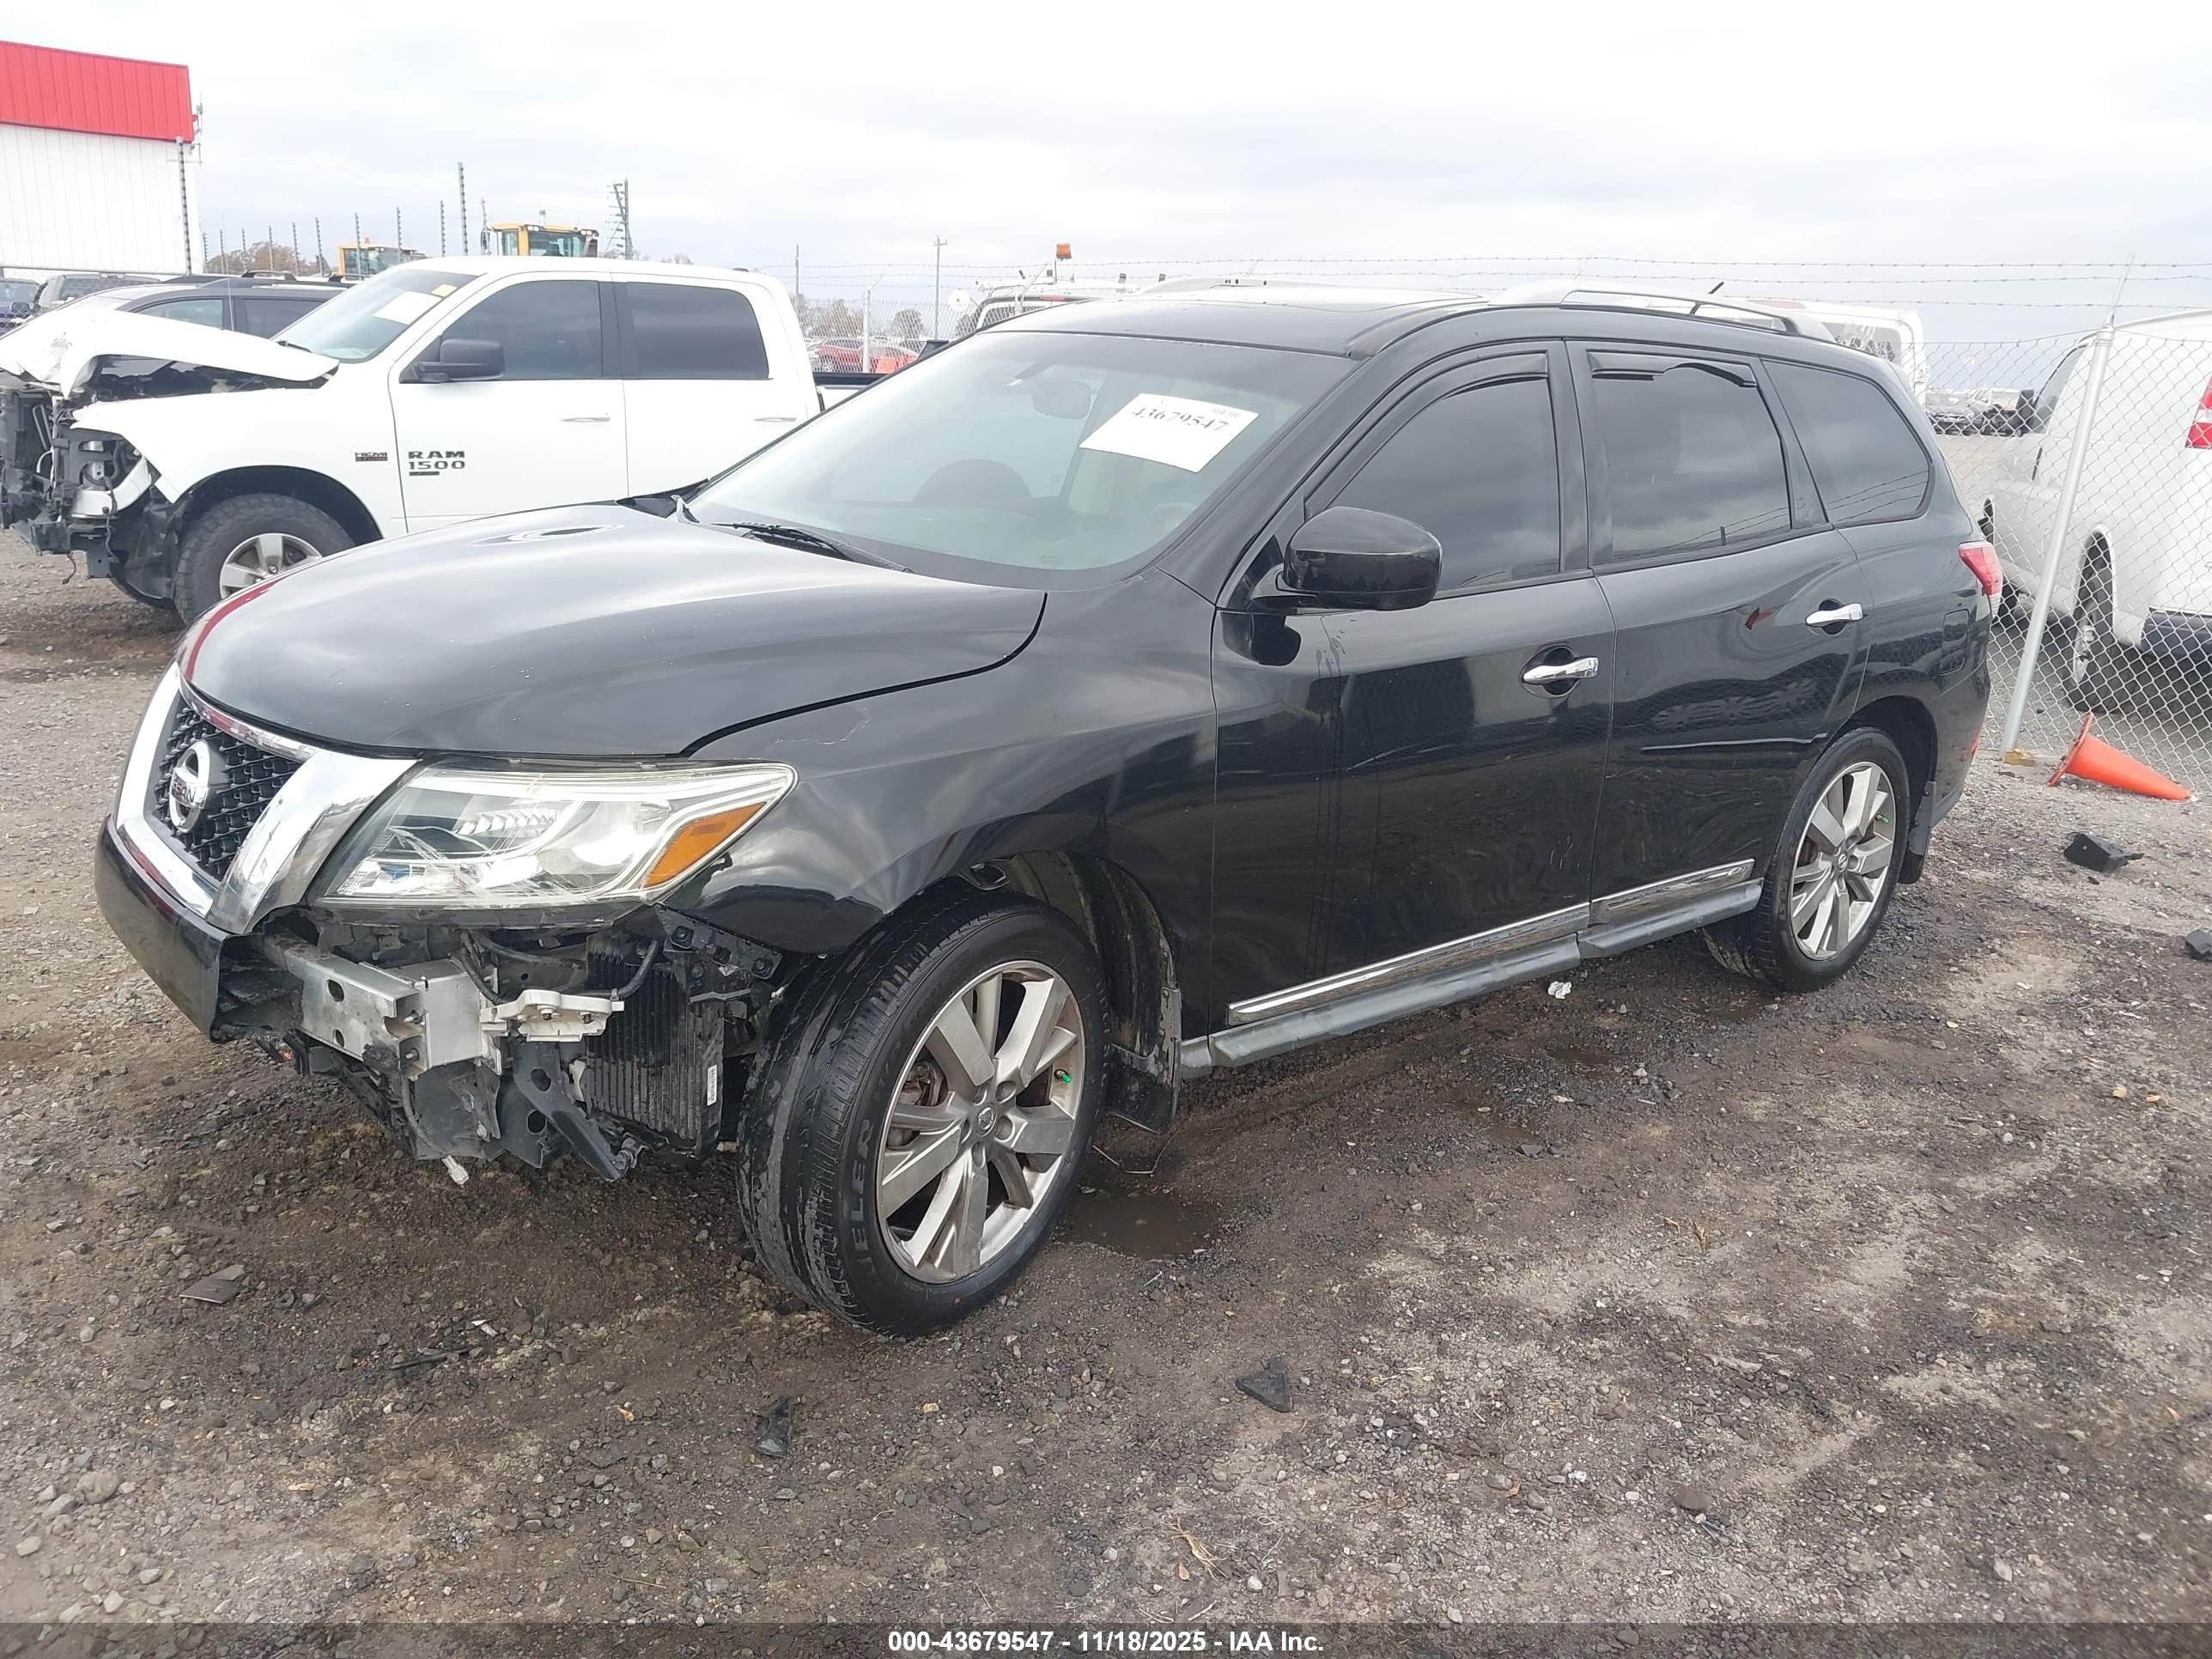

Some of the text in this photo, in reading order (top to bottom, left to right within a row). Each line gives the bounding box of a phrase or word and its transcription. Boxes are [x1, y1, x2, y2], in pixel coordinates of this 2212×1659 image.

[1131, 407, 1230, 431] 43679547
[408, 460, 465, 470] 1500
[851, 1119, 877, 1278] UELER
